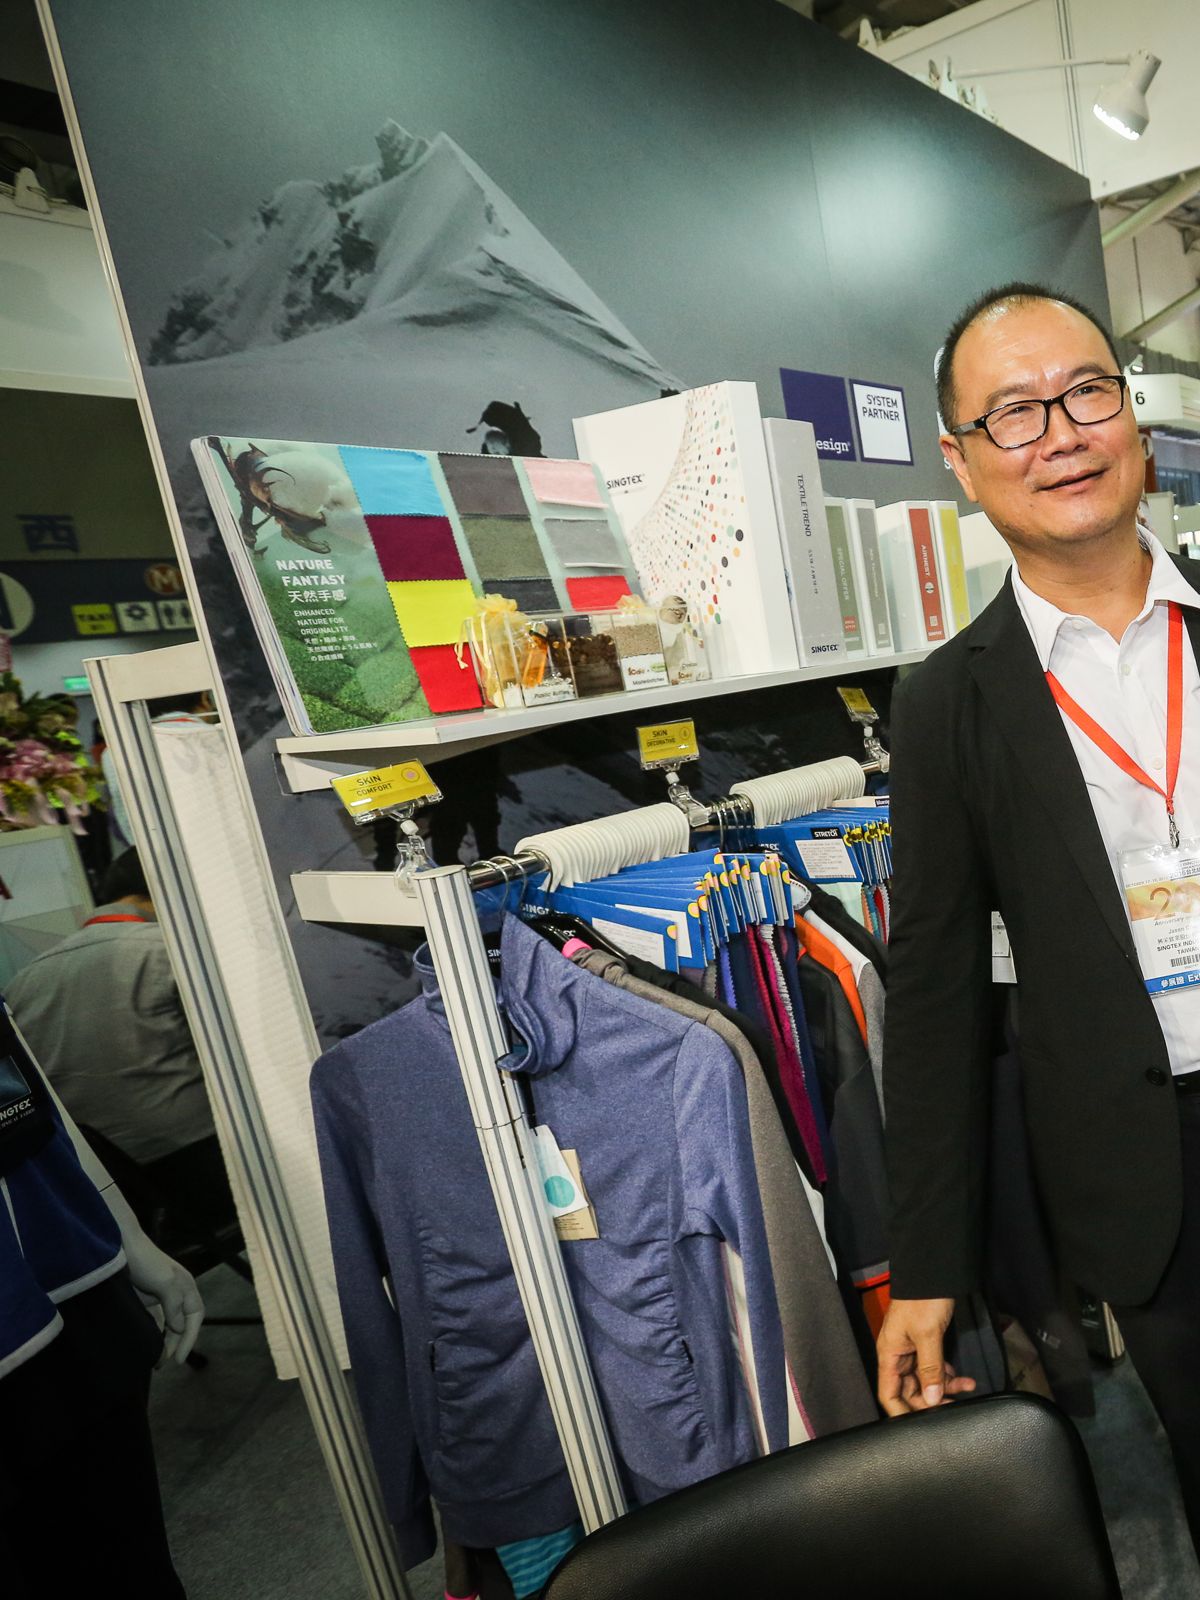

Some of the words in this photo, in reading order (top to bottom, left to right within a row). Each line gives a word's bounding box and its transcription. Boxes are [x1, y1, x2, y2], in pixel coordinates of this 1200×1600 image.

[866, 394, 898, 408] SYSTEM
[1135, 391, 1146, 405] 6
[862, 406, 900, 421] PARTNER
[816, 438, 849, 454] esign
[606, 474, 643, 489] SINGTEX
[797, 475, 808, 511] TEXTILE
[802, 509, 812, 537] TREND
[276, 559, 334, 571] NATURE
[282, 574, 345, 587] FANTASY
[288, 589, 347, 603] 天然手感
[294, 608, 335, 617] ENHANCED
[297, 618, 328, 626] NATURE
[329, 616, 345, 624] FOR
[301, 625, 348, 635] ORIGINALITY
[811, 645, 838, 654] SINGTEX
[652, 729, 668, 737] SKIN
[356, 774, 382, 787] SKIN
[356, 782, 393, 797] COMFORT
[488, 948, 501, 957] SIN
[1157, 943, 1181, 952] SINGTEX
[0, 1098, 32, 1120] NGTEX
